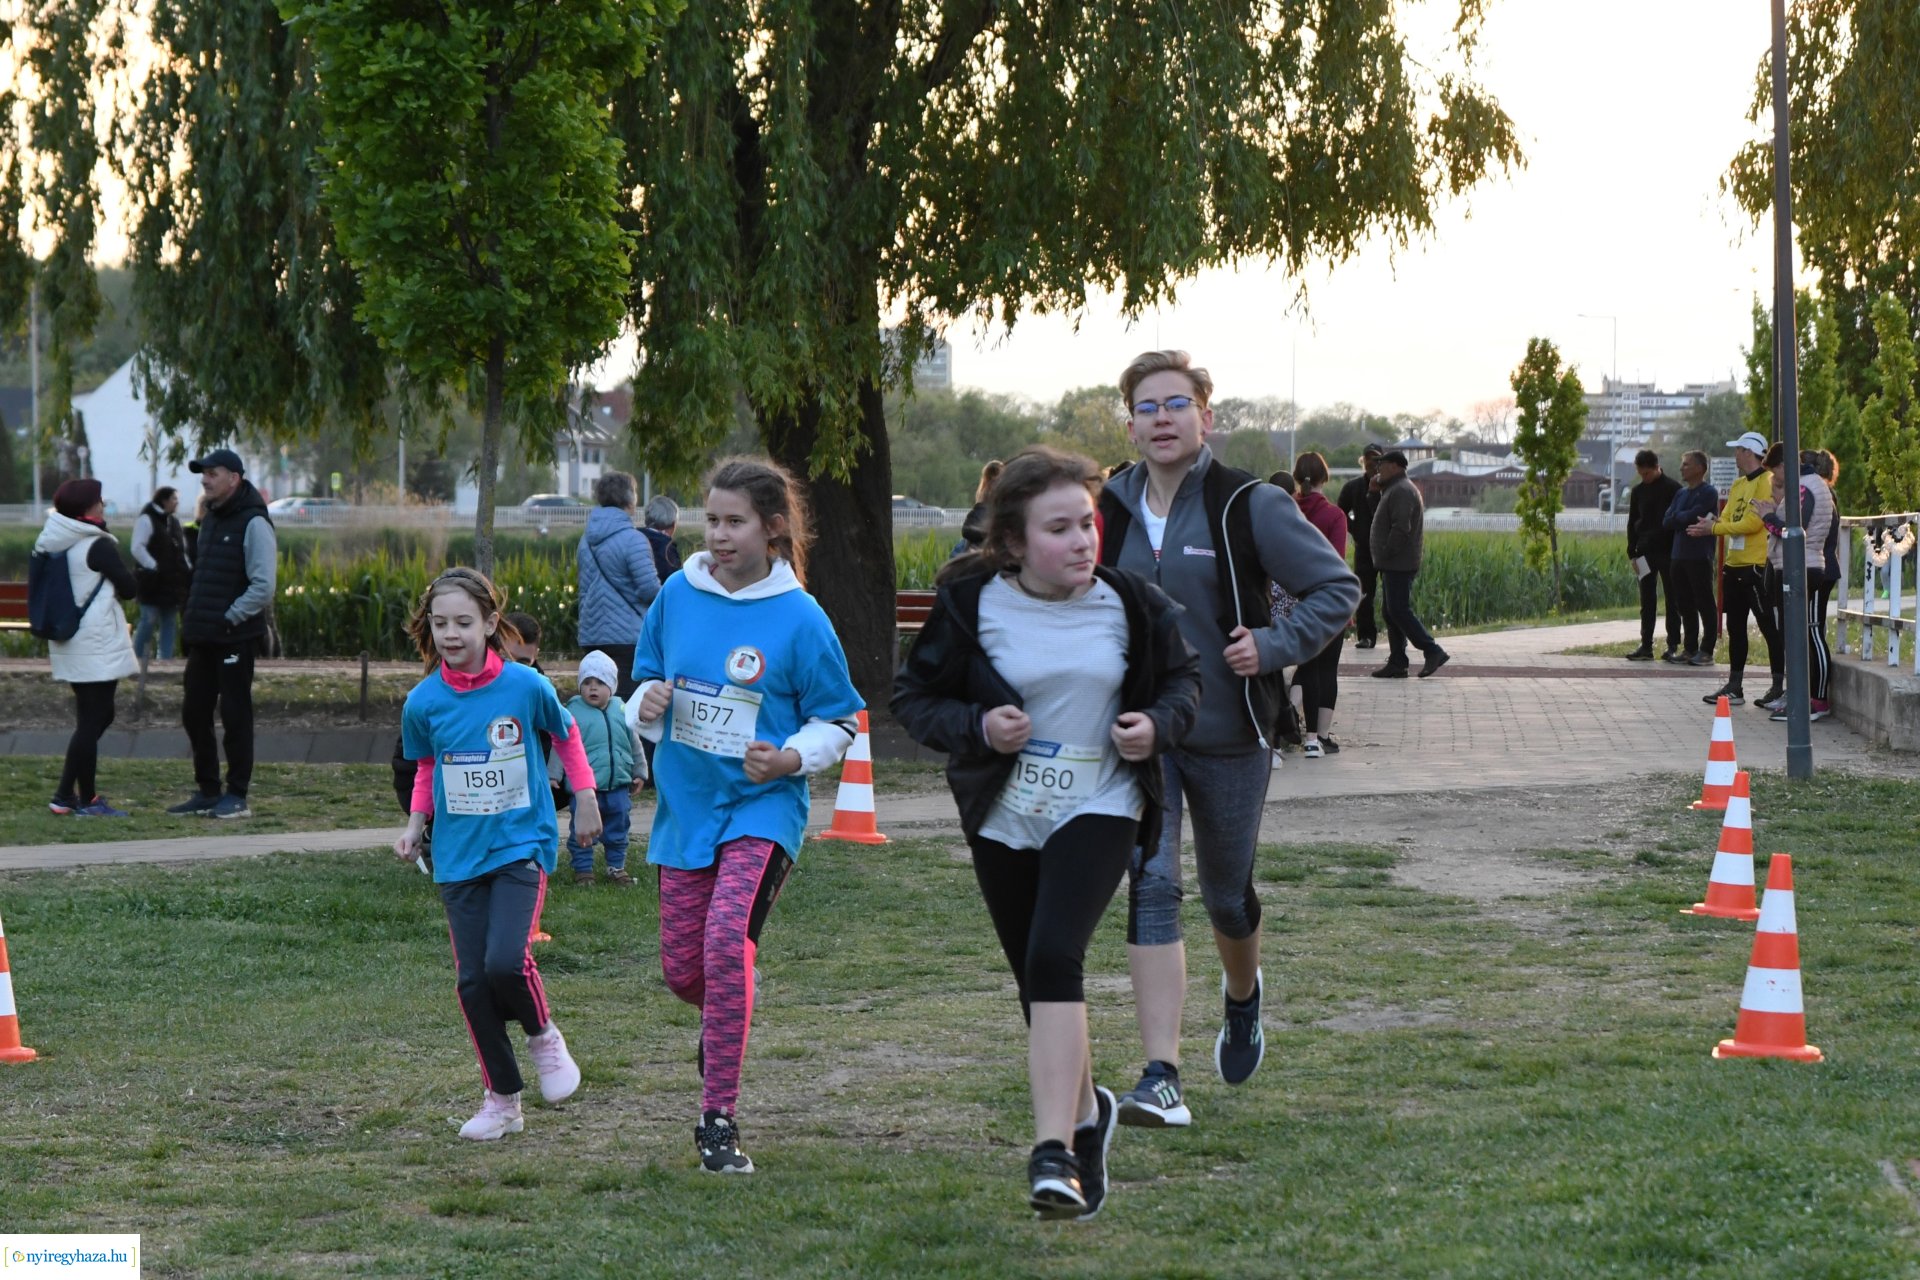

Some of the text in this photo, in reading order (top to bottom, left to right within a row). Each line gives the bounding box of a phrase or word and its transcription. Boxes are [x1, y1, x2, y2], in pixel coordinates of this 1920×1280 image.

[691, 700, 734, 726] 1577
[463, 769, 505, 788] 1581
[1016, 760, 1074, 790] 1560
